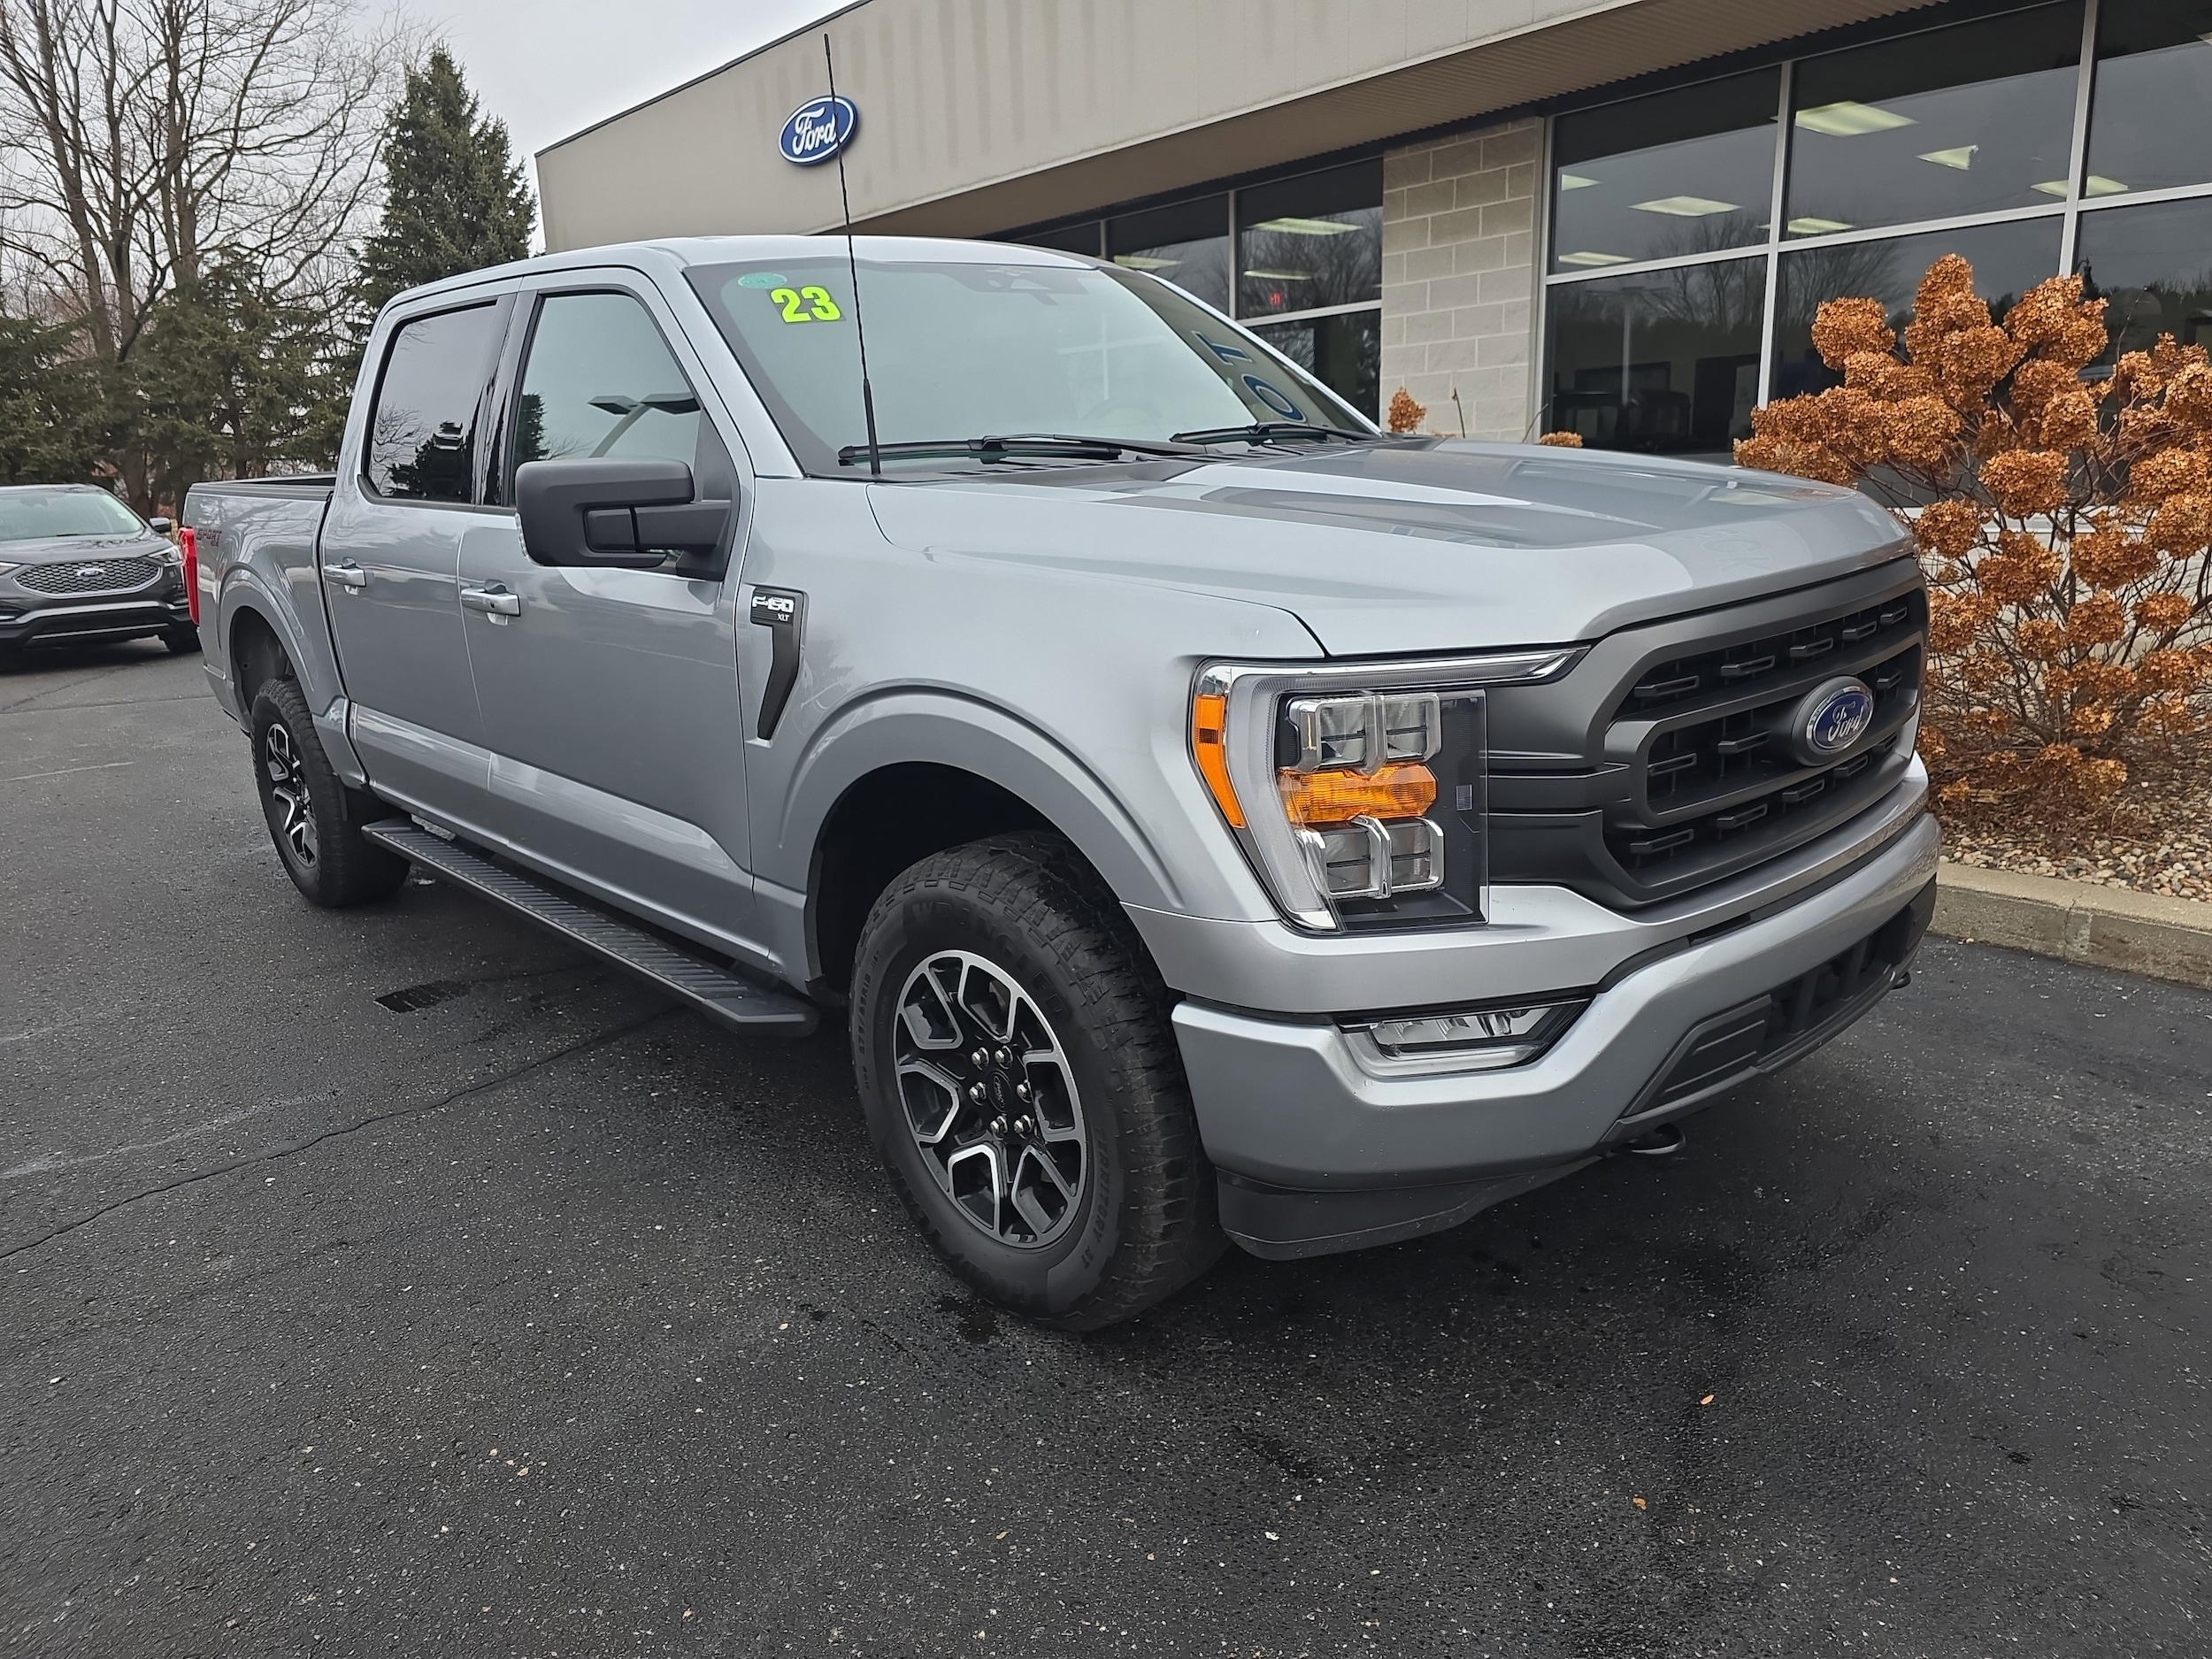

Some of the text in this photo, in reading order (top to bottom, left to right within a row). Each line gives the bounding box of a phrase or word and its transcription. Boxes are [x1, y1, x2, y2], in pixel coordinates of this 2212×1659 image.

[792, 106, 837, 156] Ford
[771, 286, 841, 323] 23
[778, 613, 790, 622] XLT
[1828, 700, 1864, 742] Ford
[993, 1075, 1006, 1109] Ford
[1093, 1126, 1111, 1243] TERRITORY
